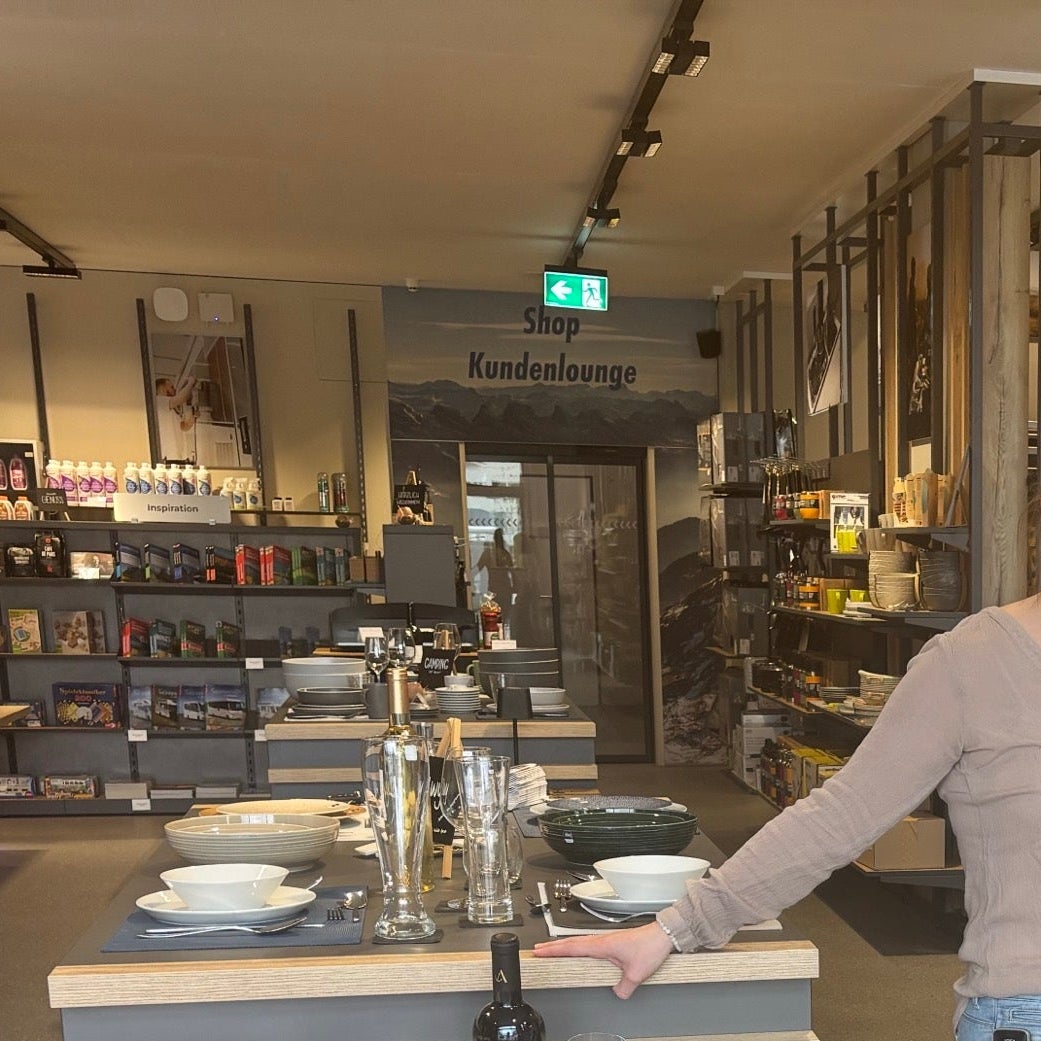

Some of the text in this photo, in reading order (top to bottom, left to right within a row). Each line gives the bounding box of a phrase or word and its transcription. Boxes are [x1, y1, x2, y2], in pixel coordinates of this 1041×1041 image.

[523, 306, 580, 343] Shop
[468, 351, 637, 391] Kundenlounge
[147, 503, 199, 513] Inspiration
[424, 657, 449, 670] CAMPING
